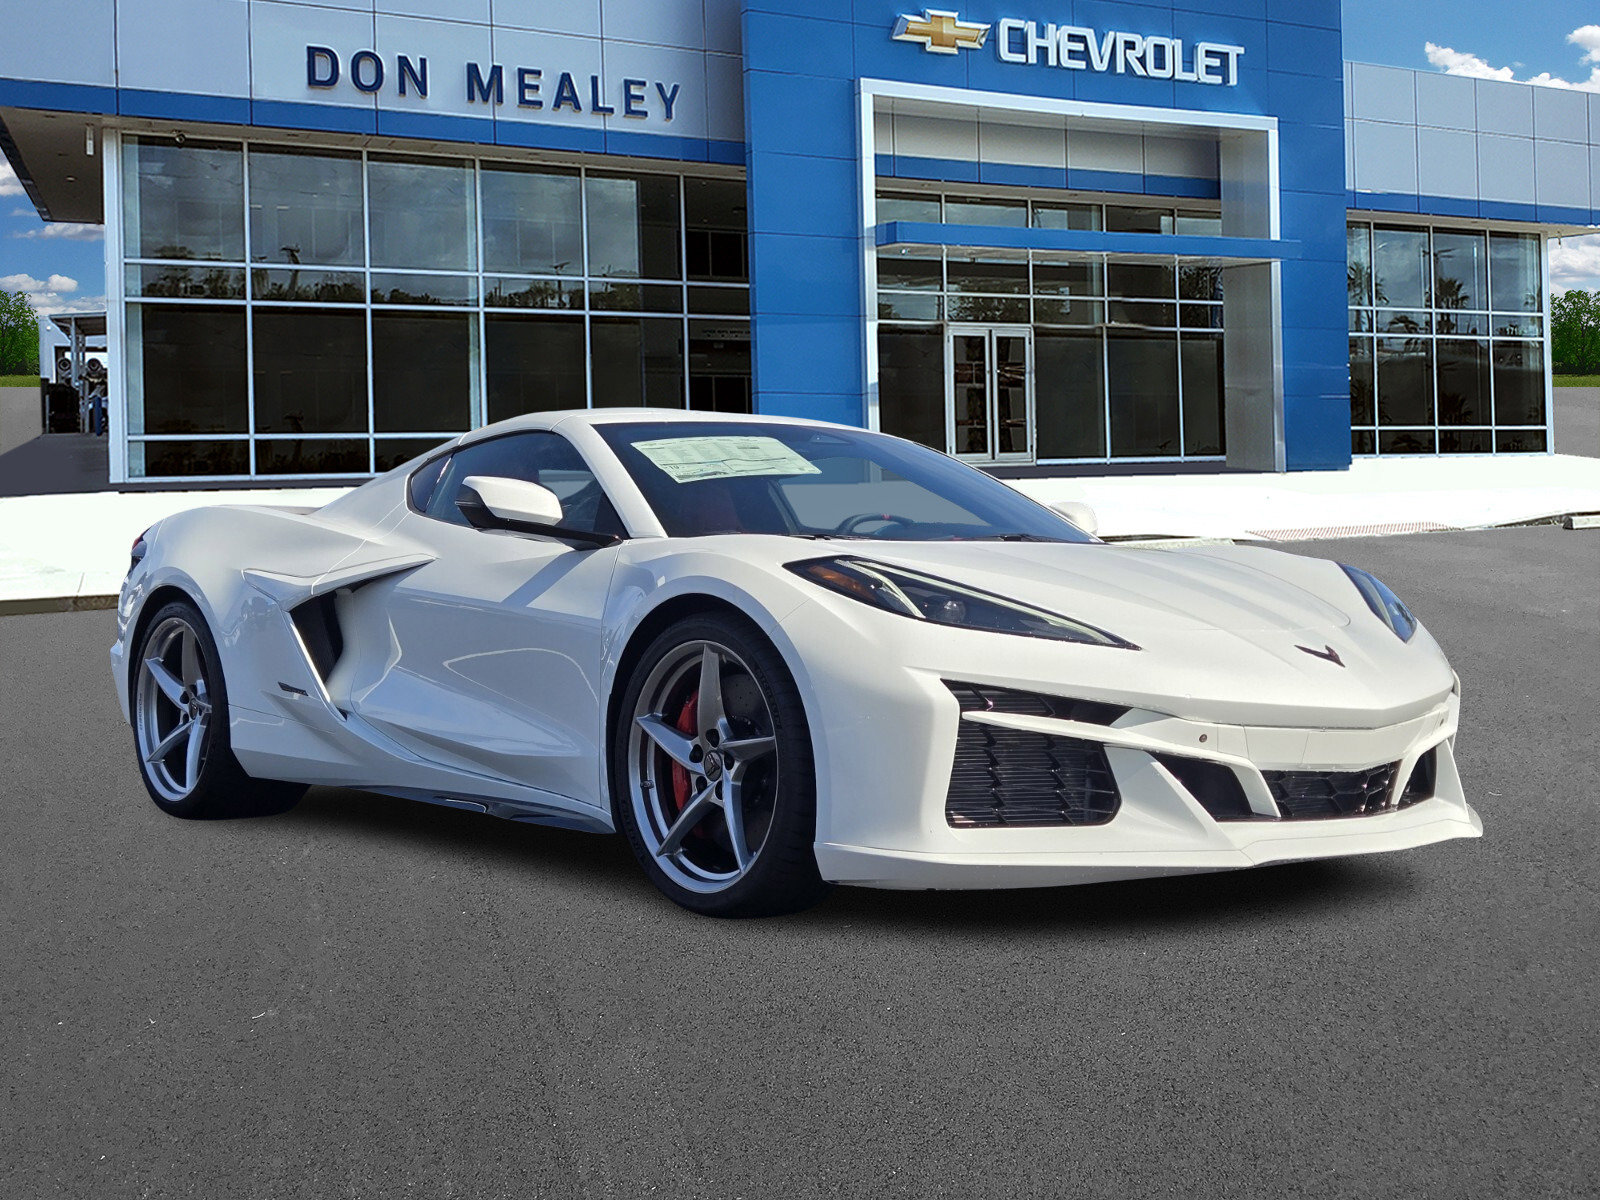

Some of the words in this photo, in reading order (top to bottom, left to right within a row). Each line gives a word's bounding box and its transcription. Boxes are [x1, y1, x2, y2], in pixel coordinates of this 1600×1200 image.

[306, 45, 429, 99] DON
[466, 62, 680, 122] MEALEY
[998, 17, 1245, 87] CHEVROLET
